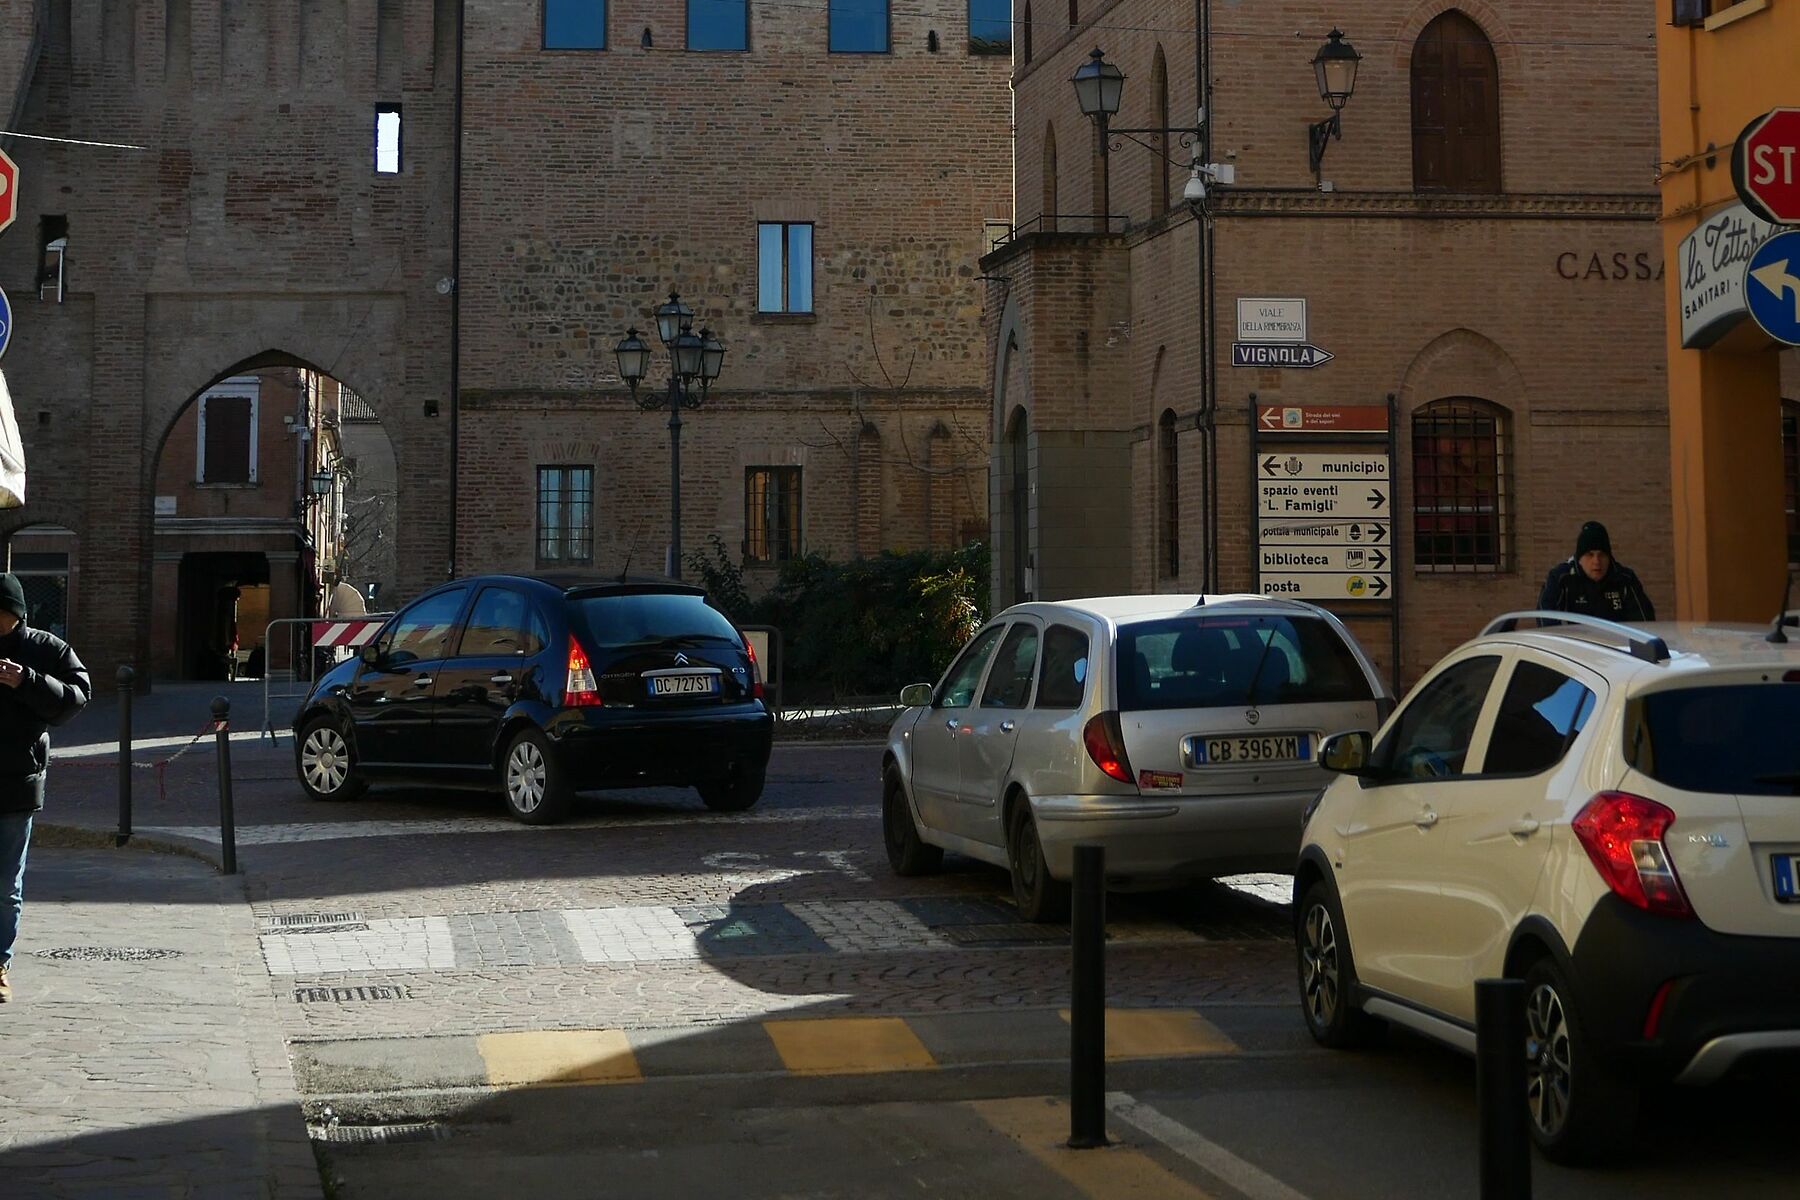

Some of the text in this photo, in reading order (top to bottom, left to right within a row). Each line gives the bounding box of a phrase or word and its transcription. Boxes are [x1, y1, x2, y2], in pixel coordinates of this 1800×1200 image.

[1685, 279, 1730, 319] SANITARI
[1259, 308, 1285, 317] VIALE
[1242, 321, 1262, 331] DELLA
[1240, 347, 1311, 363] VIGNOLA
[1322, 461, 1385, 475] municipio
[1263, 485, 1338, 497] spazio eventi
[1293, 525, 1339, 538] municipale
[1263, 552, 1329, 565] biblioteca
[1263, 580, 1301, 594] posta
[655, 678, 671, 693] DC
[674, 676, 710, 692] 727ST
[1209, 740, 1232, 761] CB
[1238, 737, 1298, 760] 396XM
